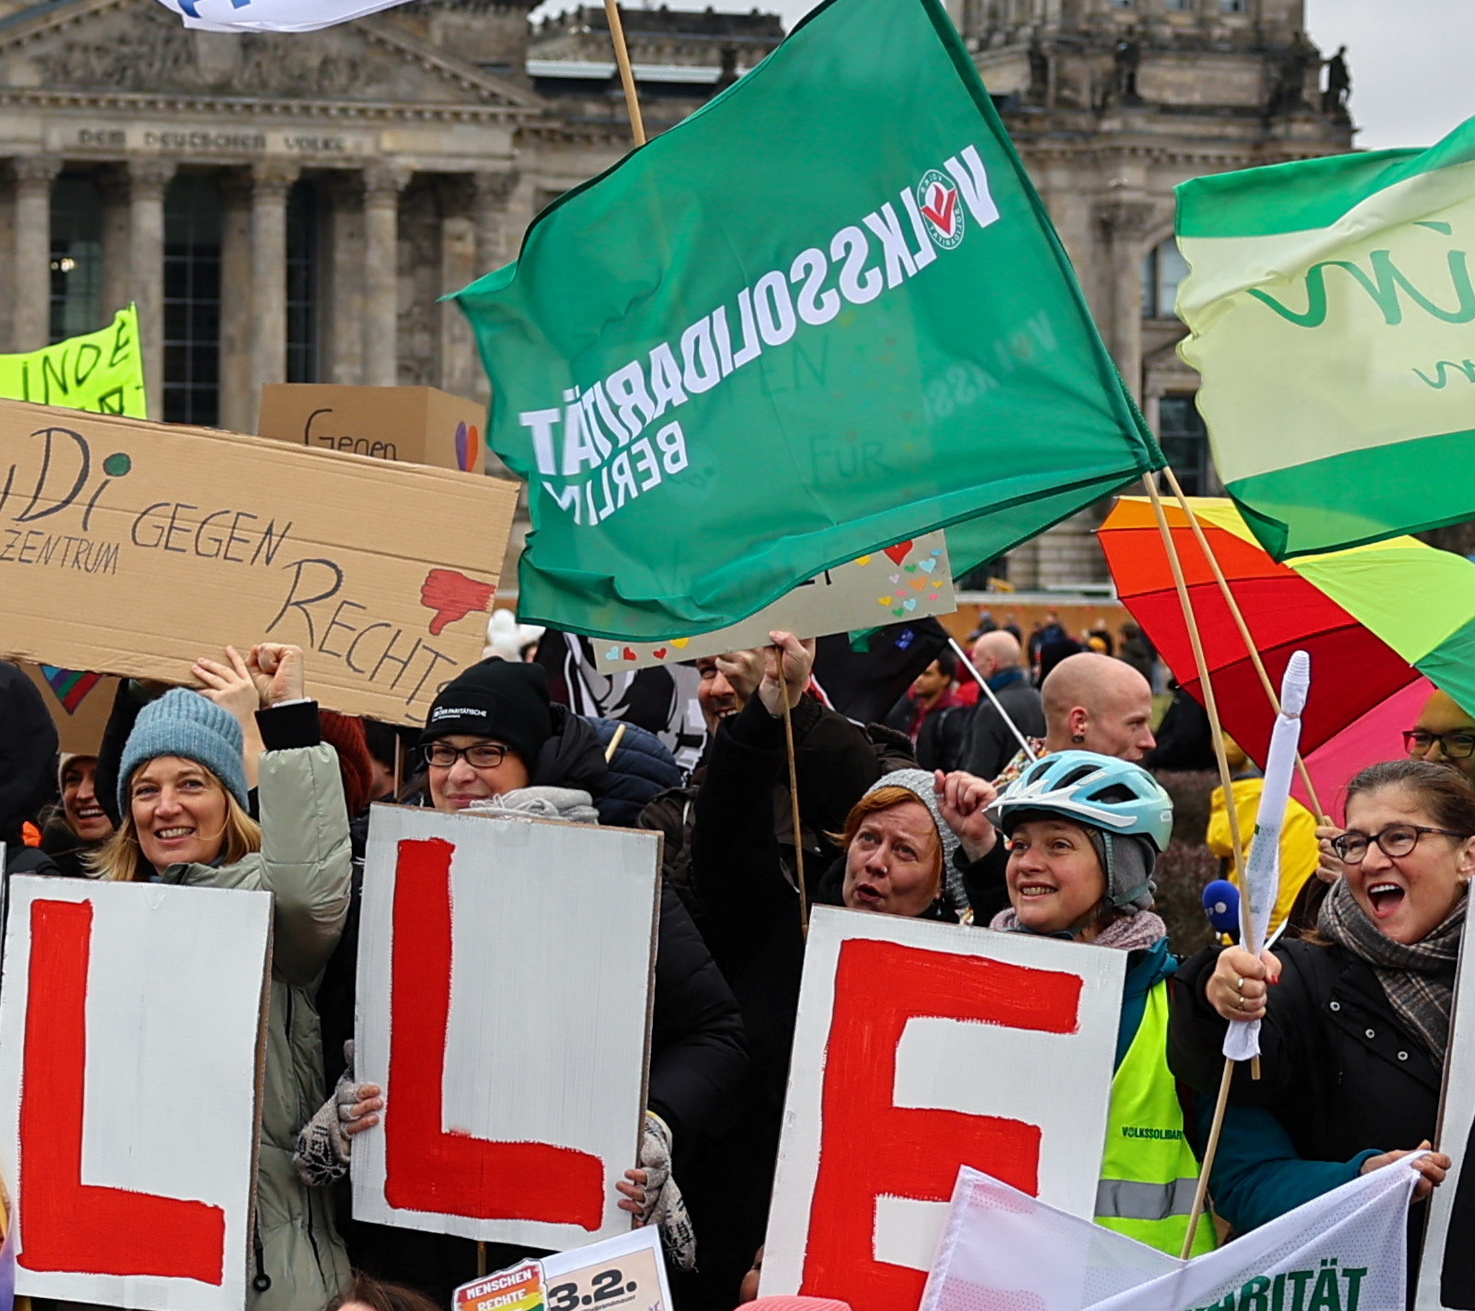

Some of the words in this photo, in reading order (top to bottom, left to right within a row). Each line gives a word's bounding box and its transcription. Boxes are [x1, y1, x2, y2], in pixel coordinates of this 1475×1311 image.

[78, 130, 125, 148] DEM
[145, 131, 266, 150] DEUTSCHEN
[284, 134, 353, 152] VOLKE
[132, 500, 293, 567] GEGEN
[466, 1269, 532, 1300] MENSCHEN
